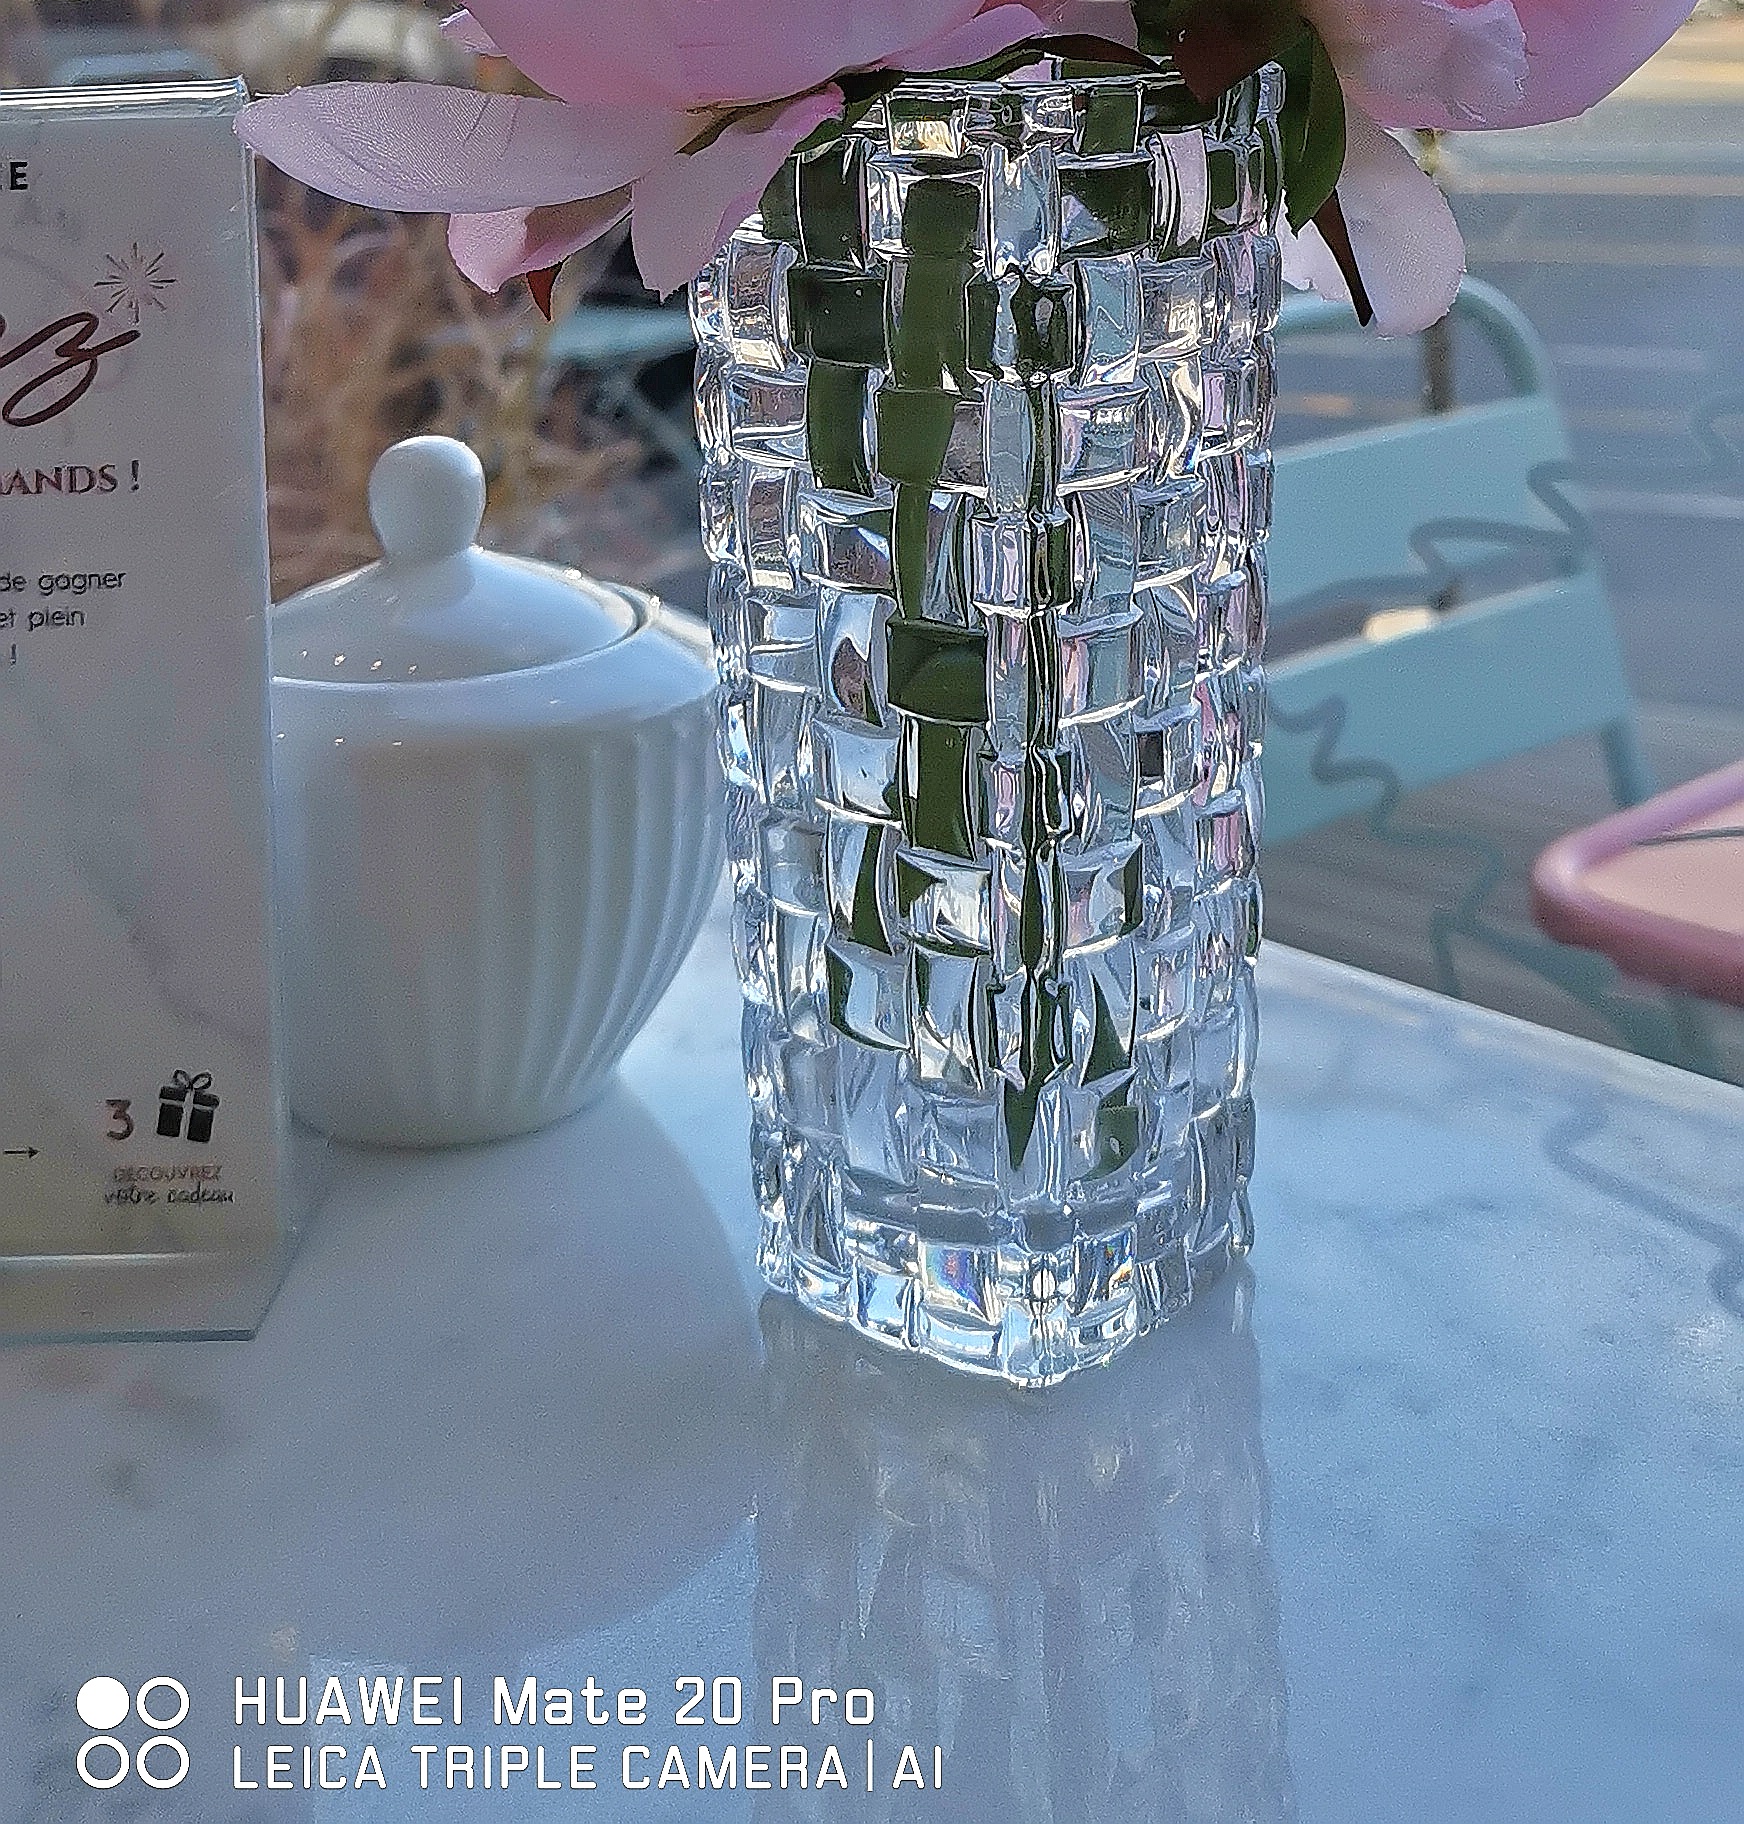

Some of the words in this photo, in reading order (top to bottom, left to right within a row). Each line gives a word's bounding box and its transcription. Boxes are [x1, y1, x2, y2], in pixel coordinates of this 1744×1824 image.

[0, 463, 118, 496] ANDS
[38, 572, 127, 597] gagner
[27, 606, 86, 632] plein
[104, 1098, 135, 1141] 3
